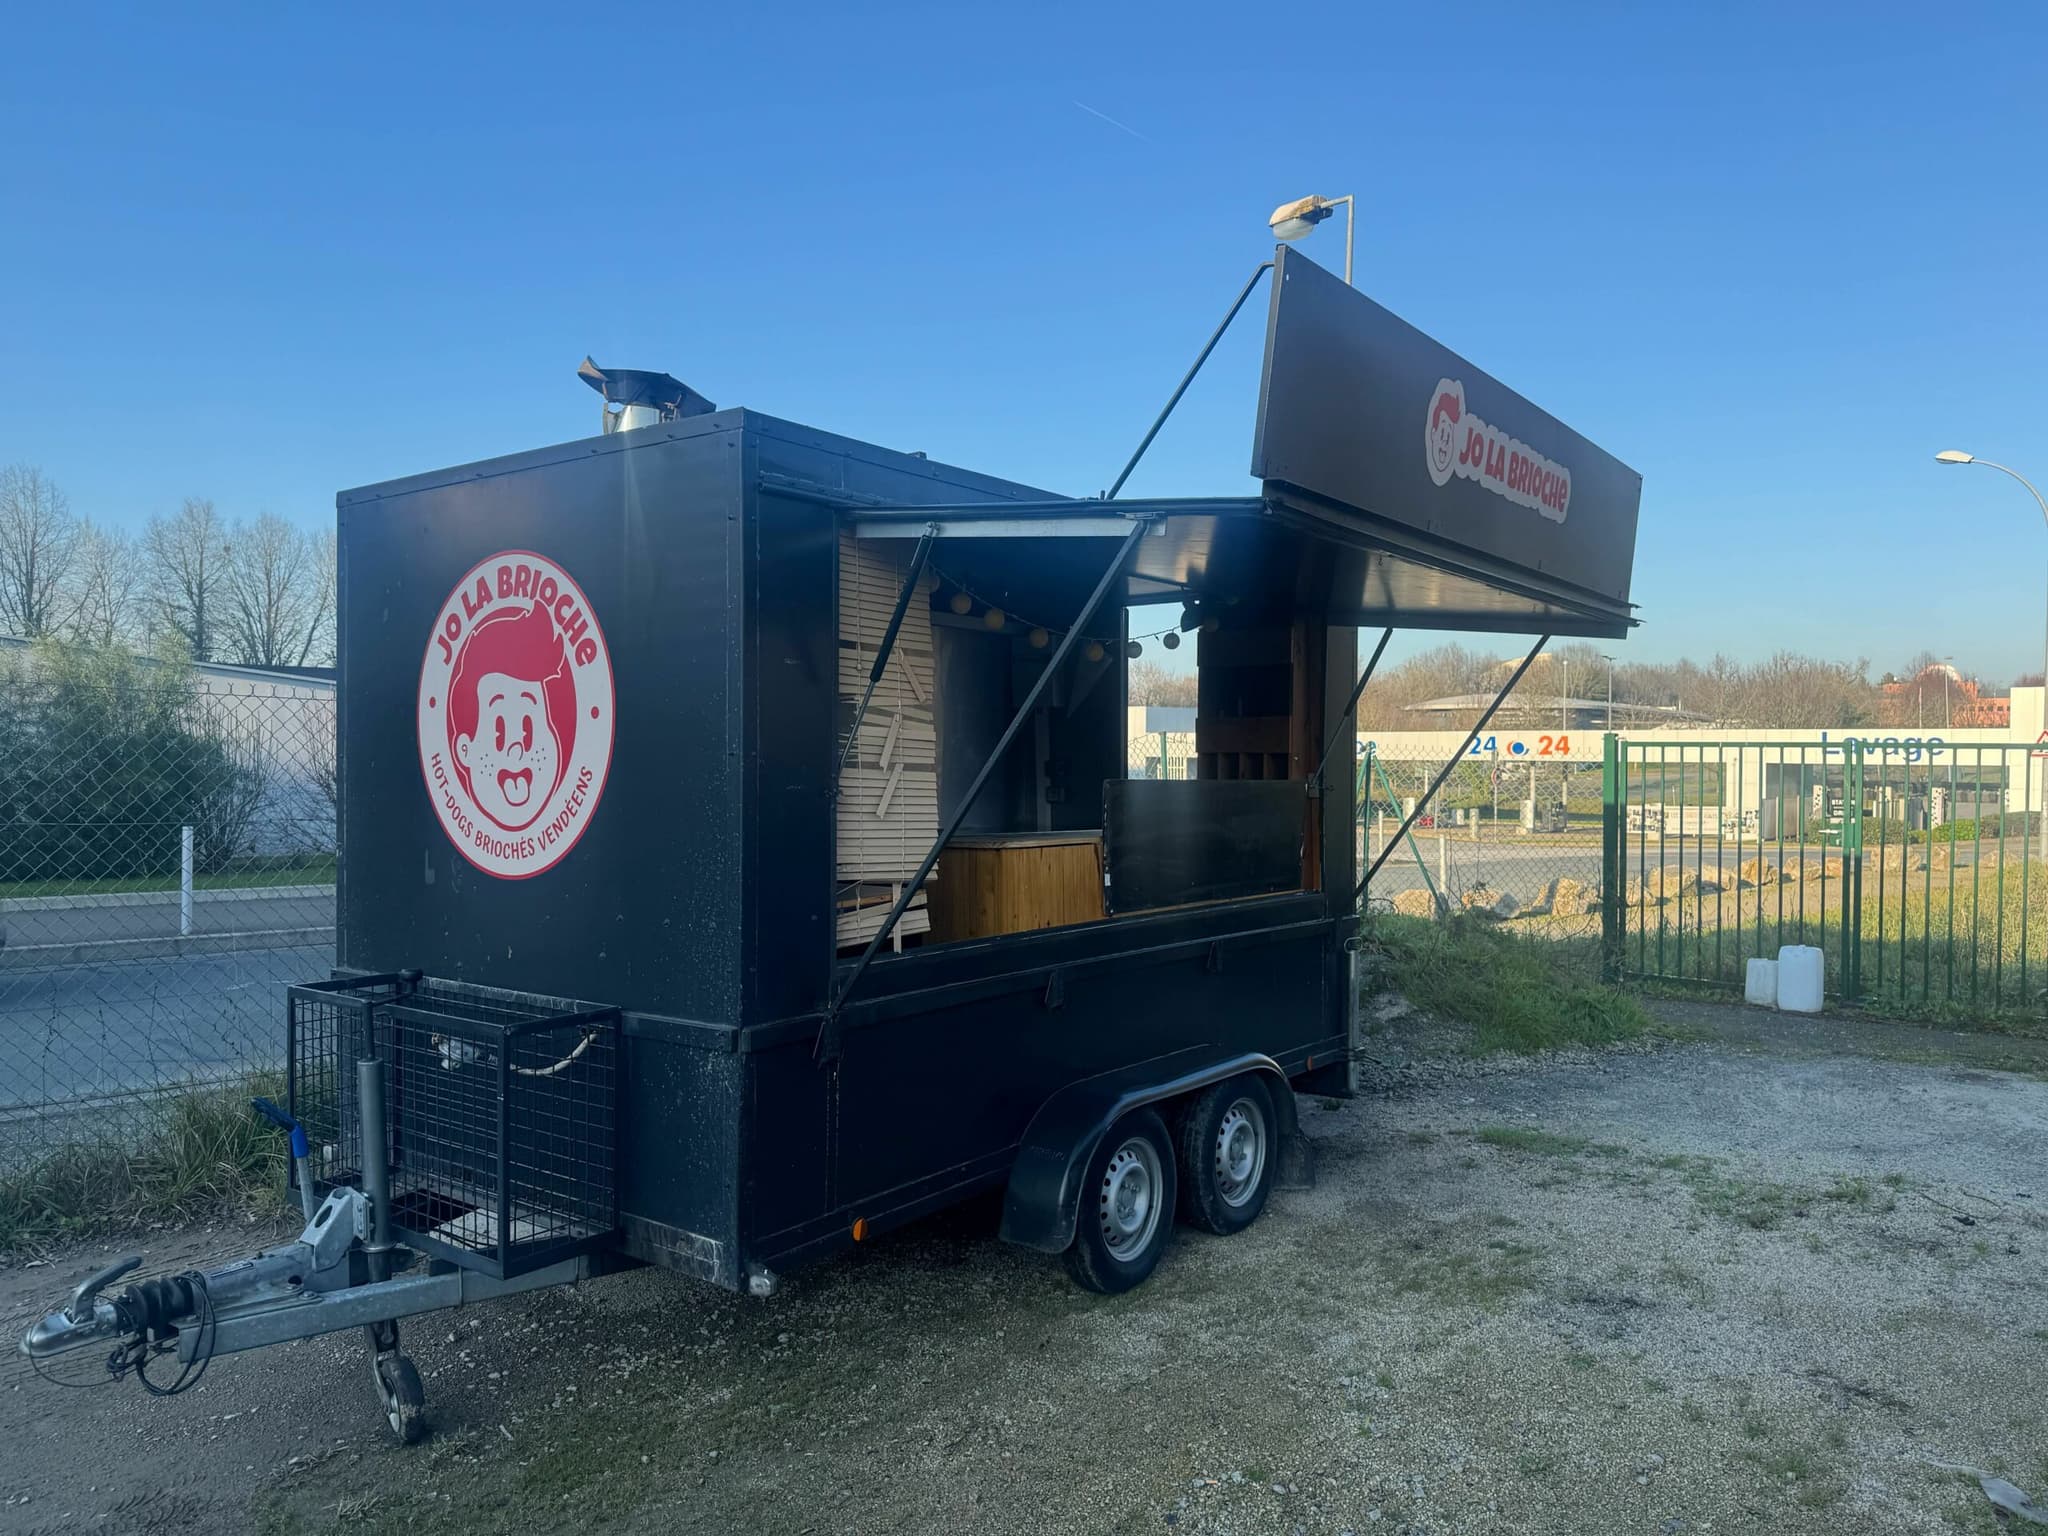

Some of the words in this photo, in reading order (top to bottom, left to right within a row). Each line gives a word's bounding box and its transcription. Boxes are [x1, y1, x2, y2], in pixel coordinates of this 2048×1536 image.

[1459, 427, 1484, 468] JO
[1484, 439, 1505, 482] LA
[437, 613, 462, 665] JO
[461, 576, 493, 621] LA
[1469, 736, 1497, 755] 24
[1538, 735, 1570, 756] 24
[431, 752, 474, 838] HOT-DOGS
[474, 829, 535, 860] BRIOCHÉS
[537, 766, 593, 851] VENDÉENS
